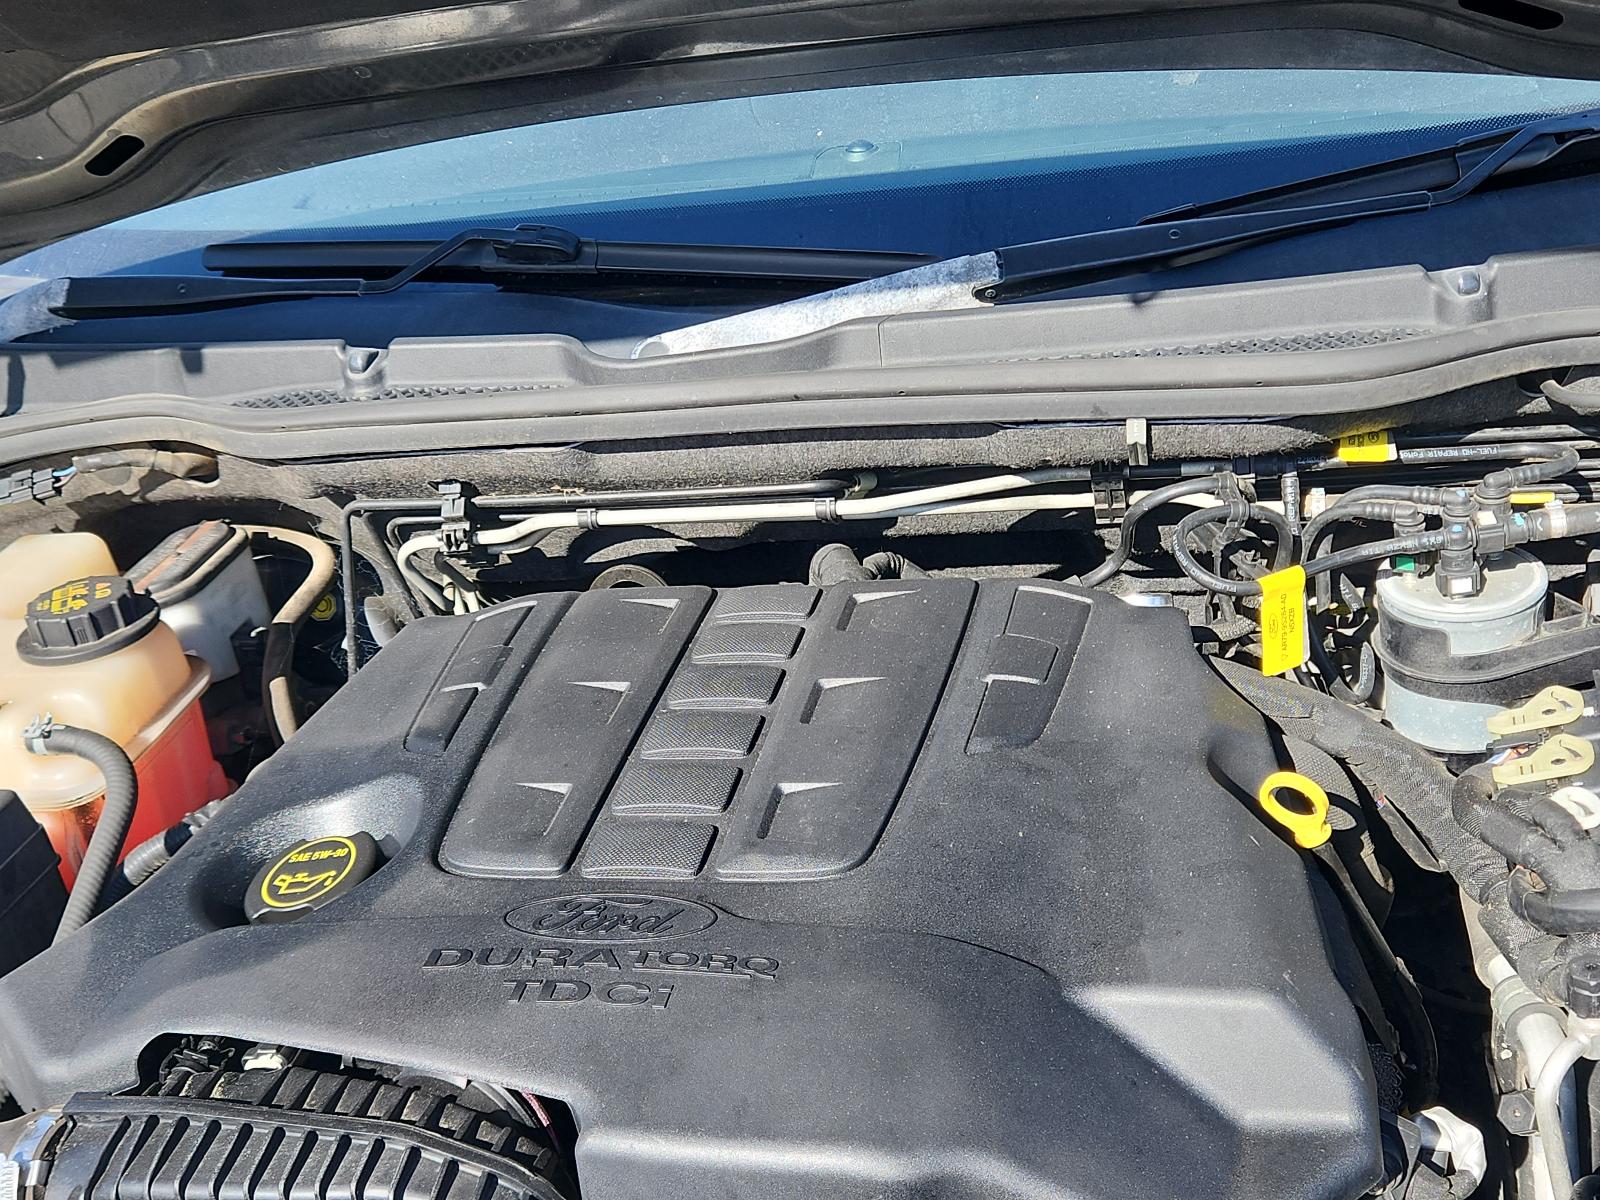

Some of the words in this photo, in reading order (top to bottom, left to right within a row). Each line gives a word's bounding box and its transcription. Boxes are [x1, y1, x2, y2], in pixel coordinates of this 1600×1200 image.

[1427, 448, 1459, 458] REPAIR
[288, 853, 313, 864] SAE
[311, 848, 349, 861] 5W-30
[532, 898, 684, 934] Ford
[422, 947, 780, 980] DURATORQ
[502, 978, 676, 1009] TDCi
